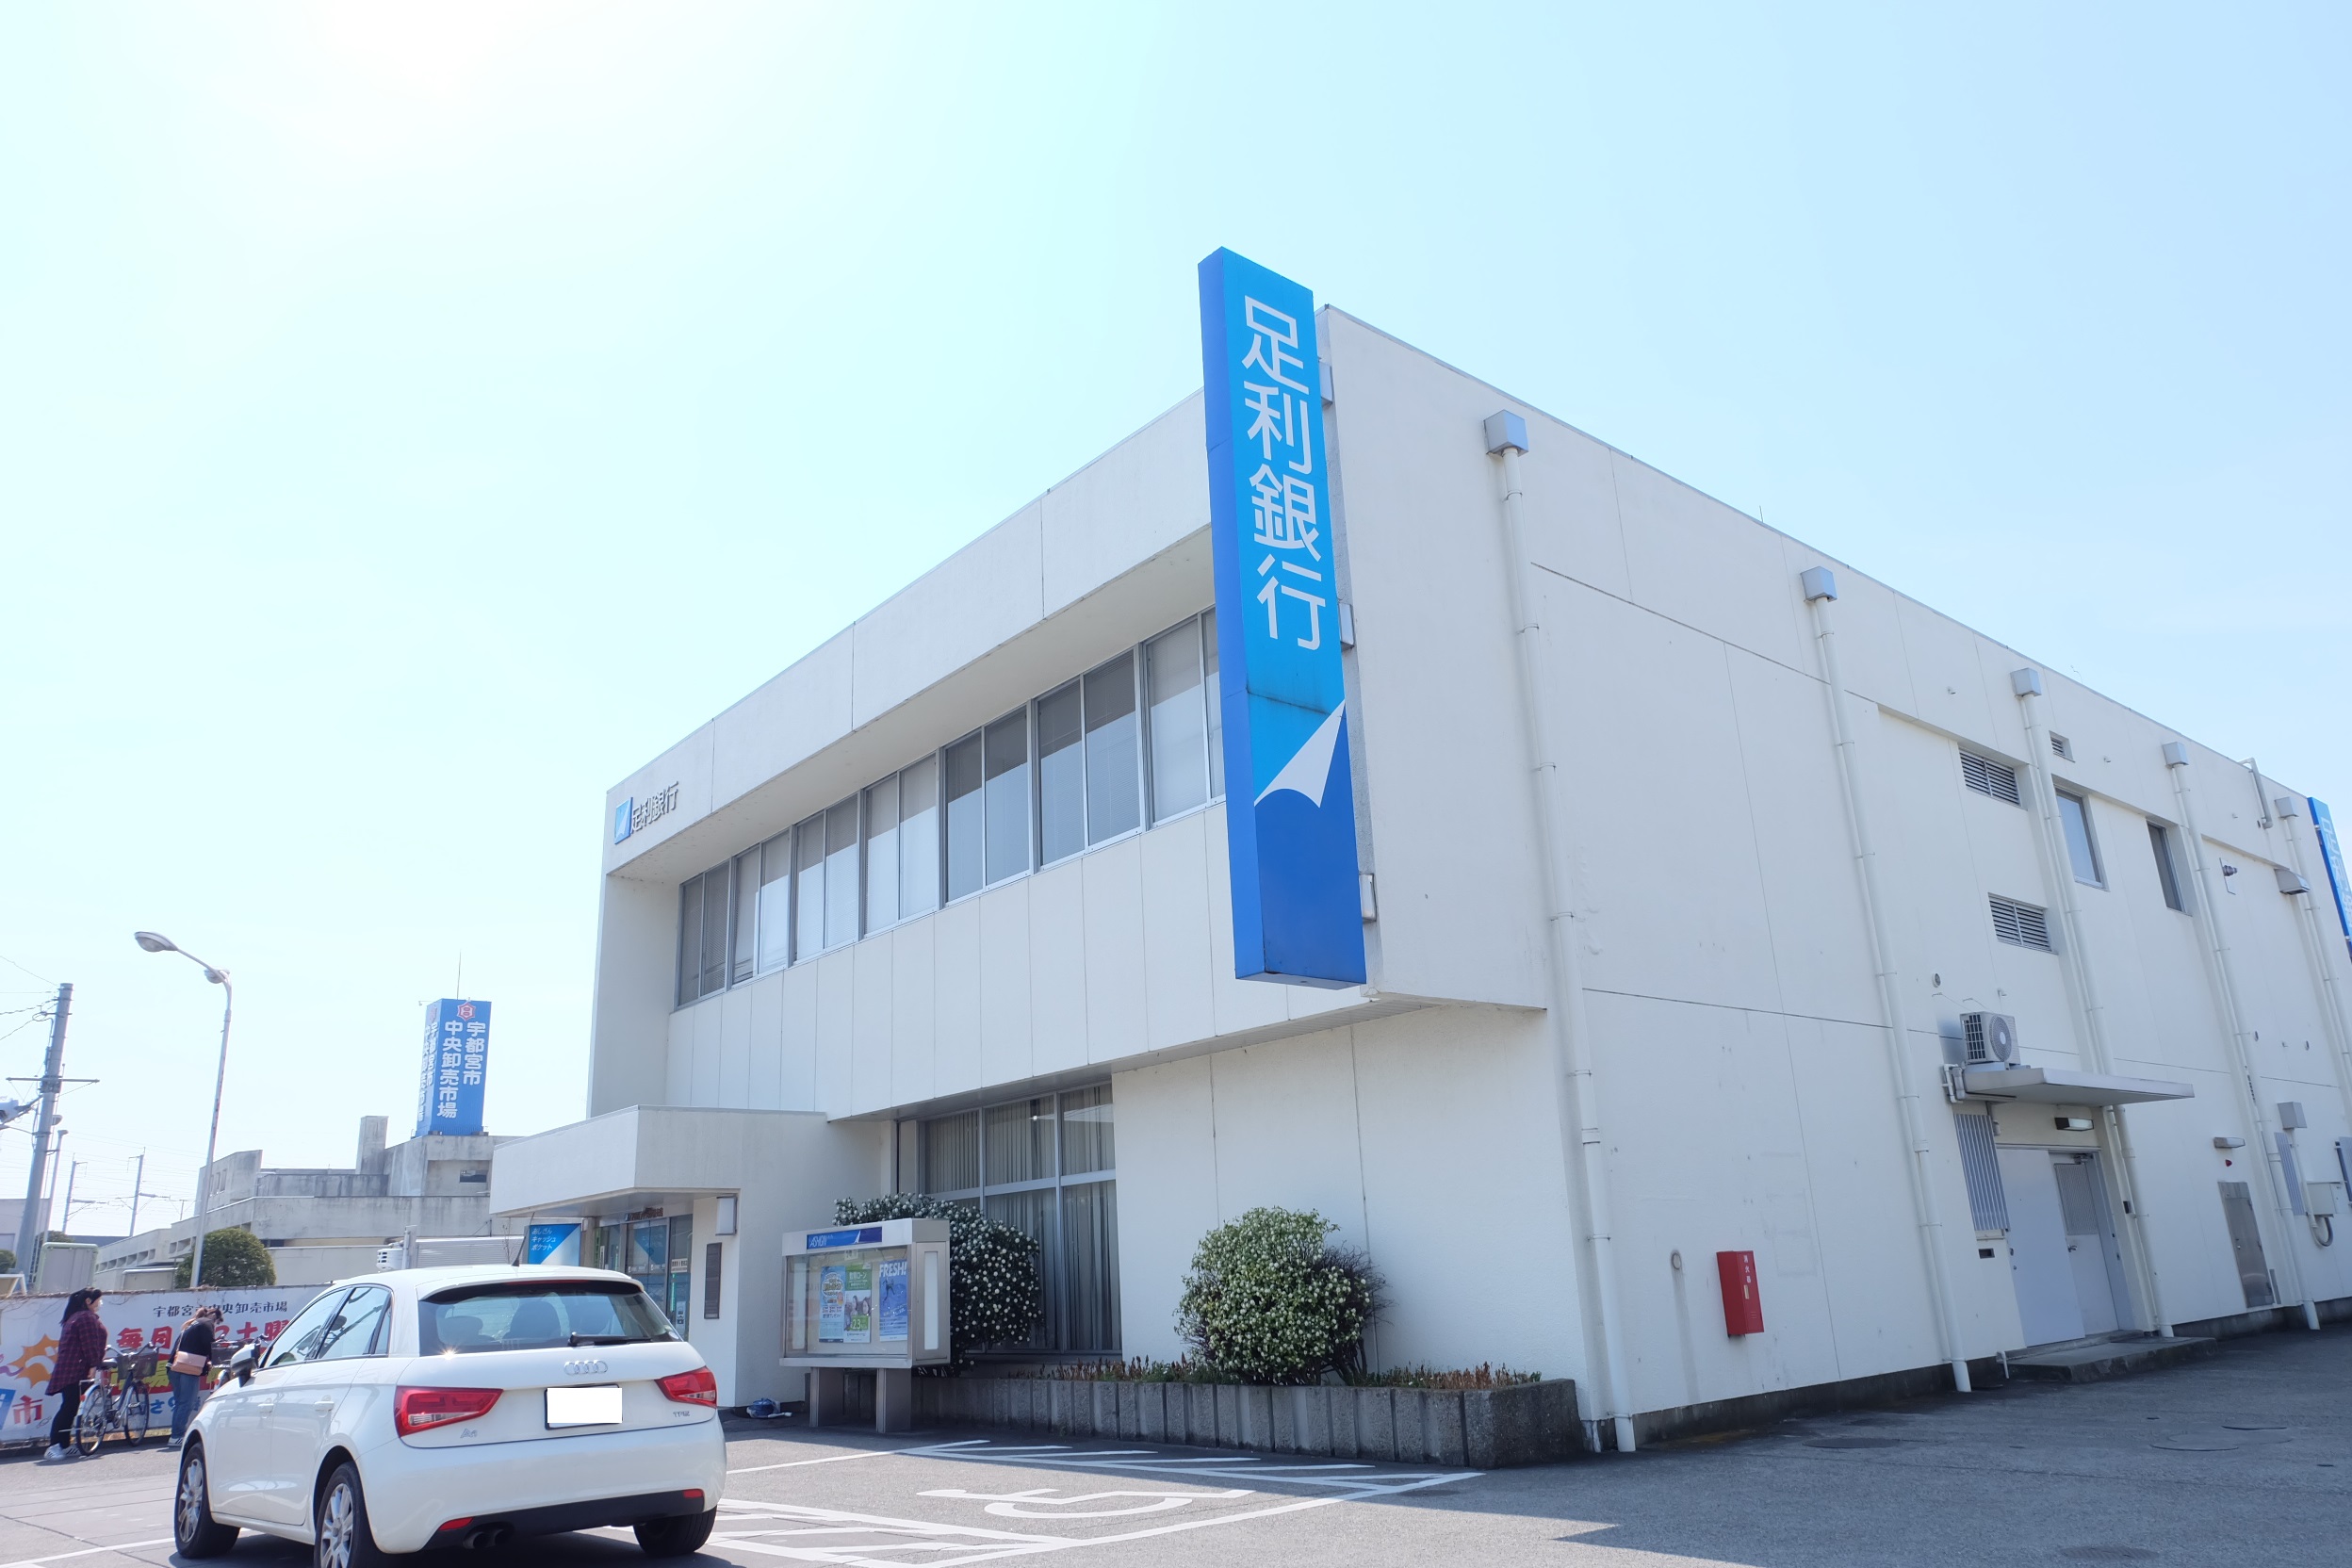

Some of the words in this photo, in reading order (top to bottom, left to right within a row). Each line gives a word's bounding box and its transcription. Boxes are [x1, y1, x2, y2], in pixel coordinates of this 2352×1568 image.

[1242, 295, 1326, 651] 足利銀行
[630, 780, 678, 834] 足利銀行
[436, 1020, 464, 1119] 中央卸売市場
[463, 1021, 486, 1086] 宇都宮市
[879, 1262, 906, 1278] FRESH!
